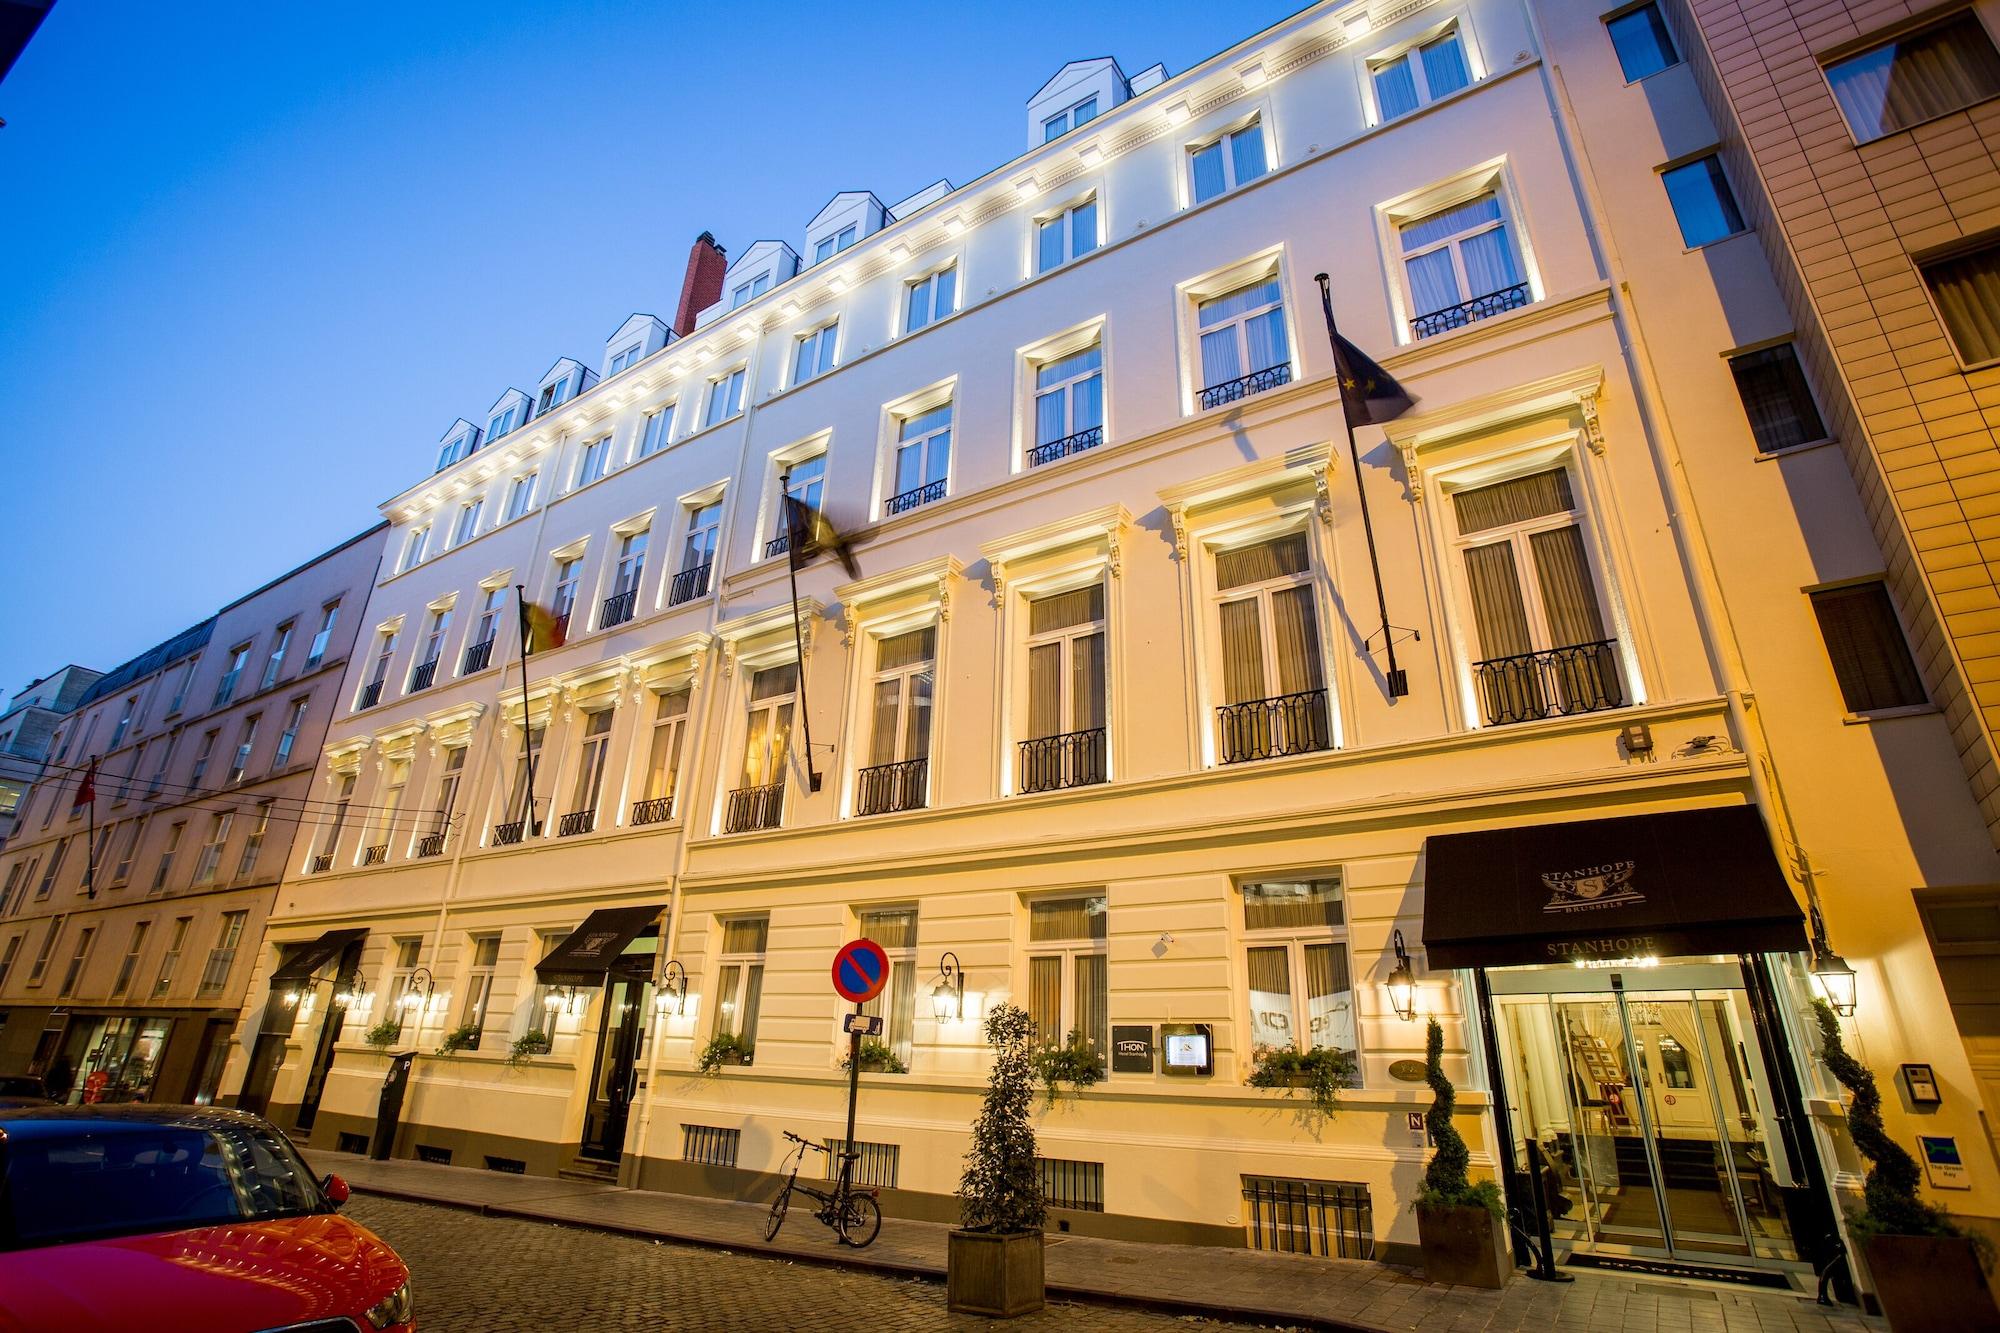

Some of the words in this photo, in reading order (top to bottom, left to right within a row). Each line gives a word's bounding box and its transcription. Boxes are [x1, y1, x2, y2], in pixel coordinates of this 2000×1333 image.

[1541, 860, 1636, 881] STANHOPE
[1583, 879, 1598, 892] S
[1565, 901, 1623, 913] BRUSSELS
[1547, 936, 1656, 956] STANHOPE
[1117, 1040, 1148, 1051] THON
[403, 1061, 411, 1070] P
